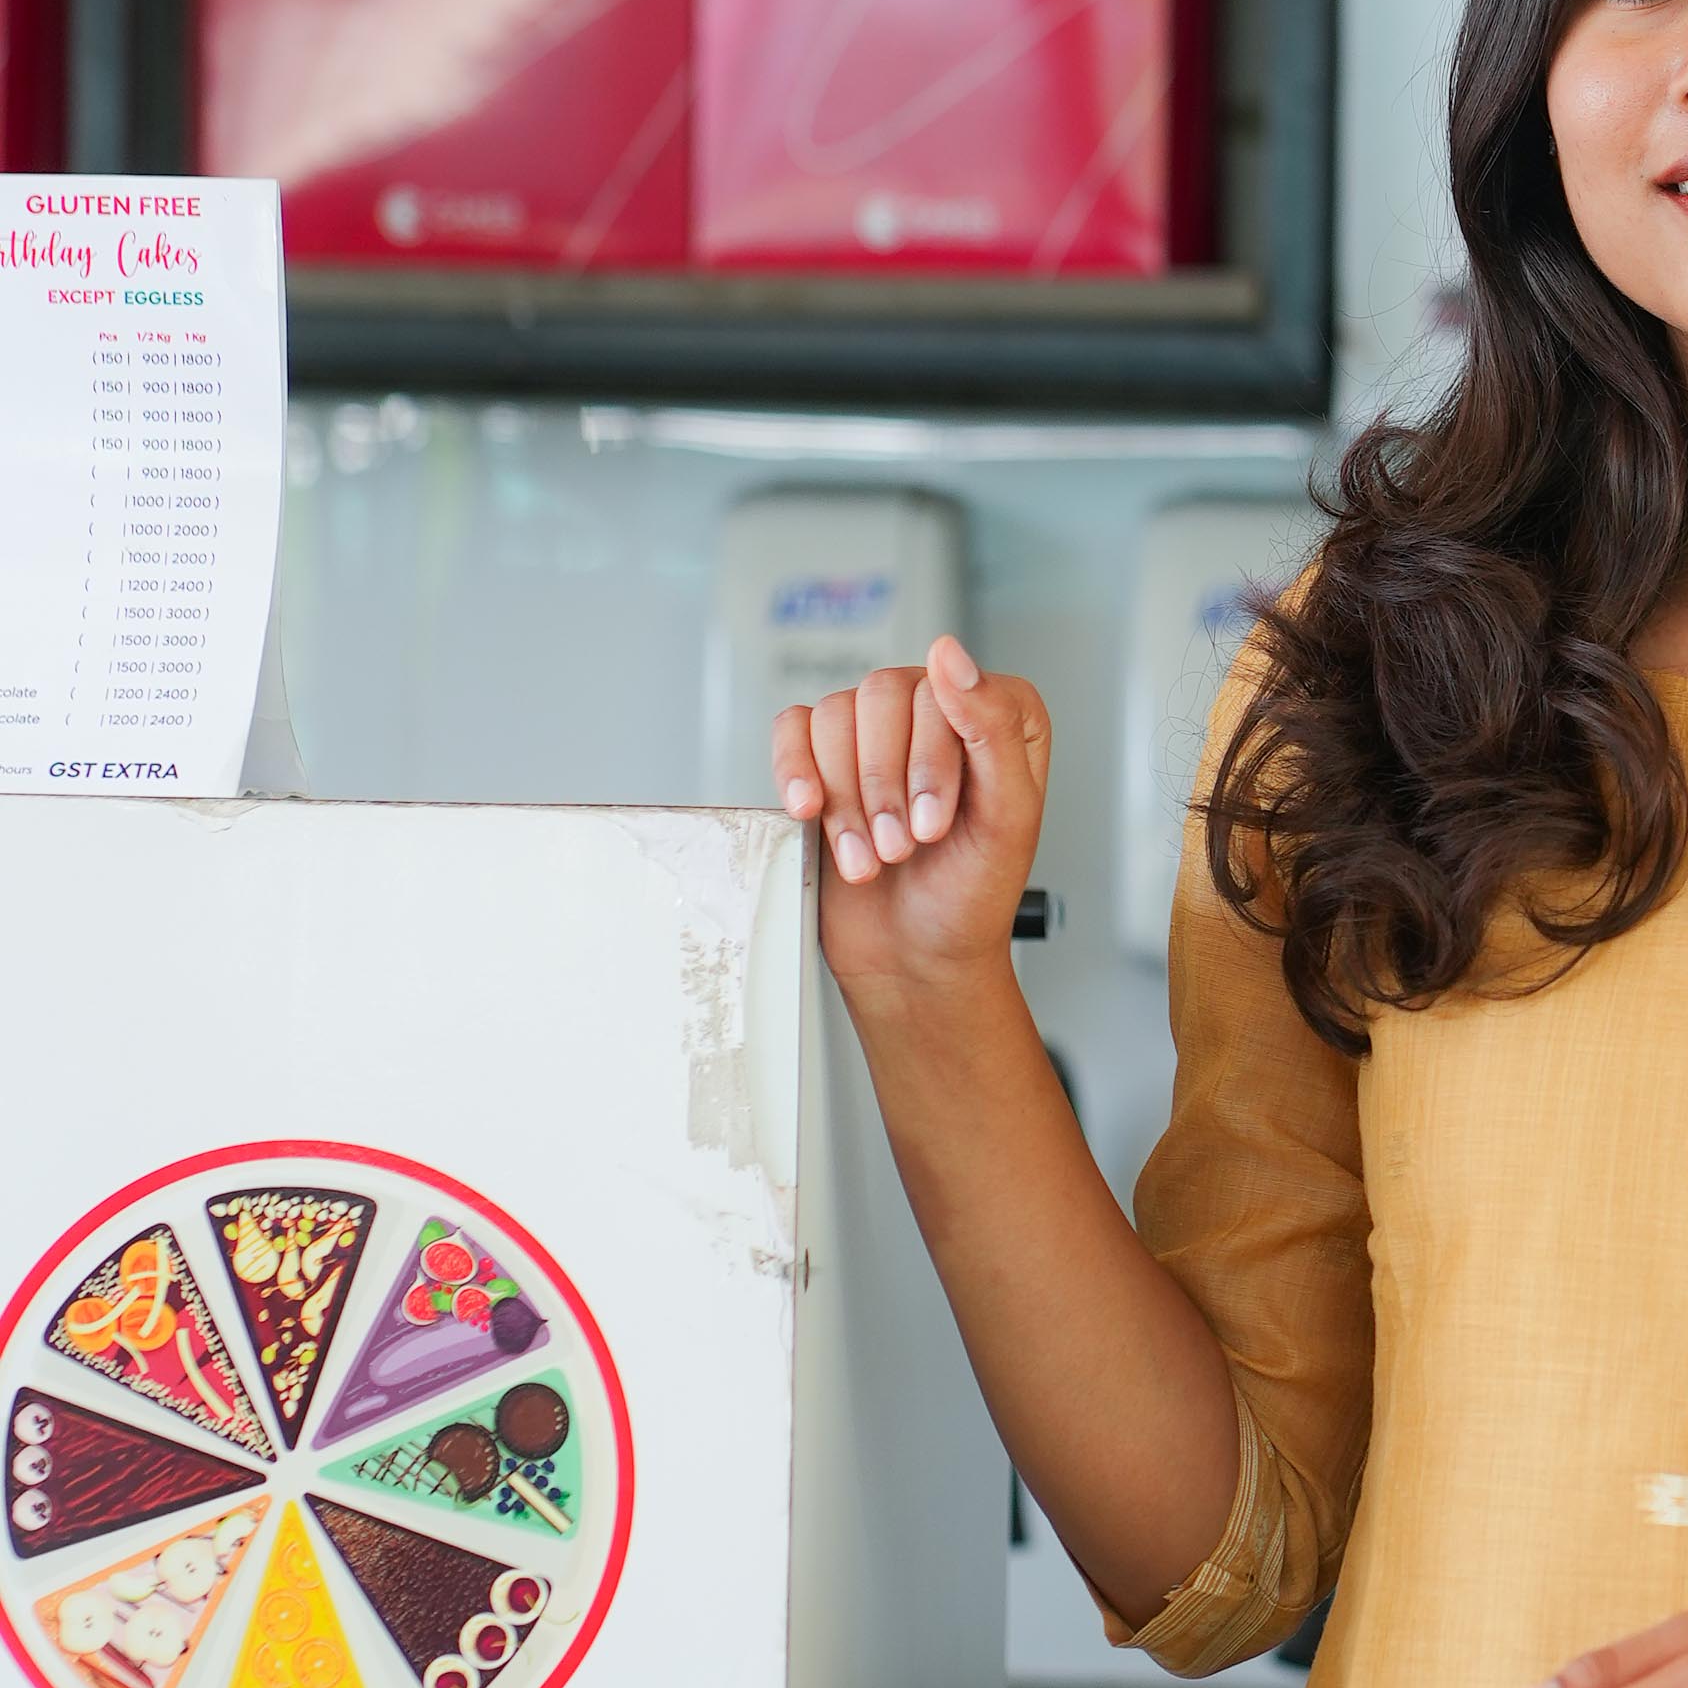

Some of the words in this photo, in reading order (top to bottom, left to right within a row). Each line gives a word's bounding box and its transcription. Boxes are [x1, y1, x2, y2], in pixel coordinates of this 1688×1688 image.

[26, 195, 131, 215] GLUTEN
[139, 197, 201, 217] FREE
[116, 230, 202, 278] Cakes
[48, 289, 115, 304] EXCEPT
[124, 291, 204, 305] EGGLESS
[49, 762, 97, 778] GST
[102, 763, 179, 779] EXTRA
